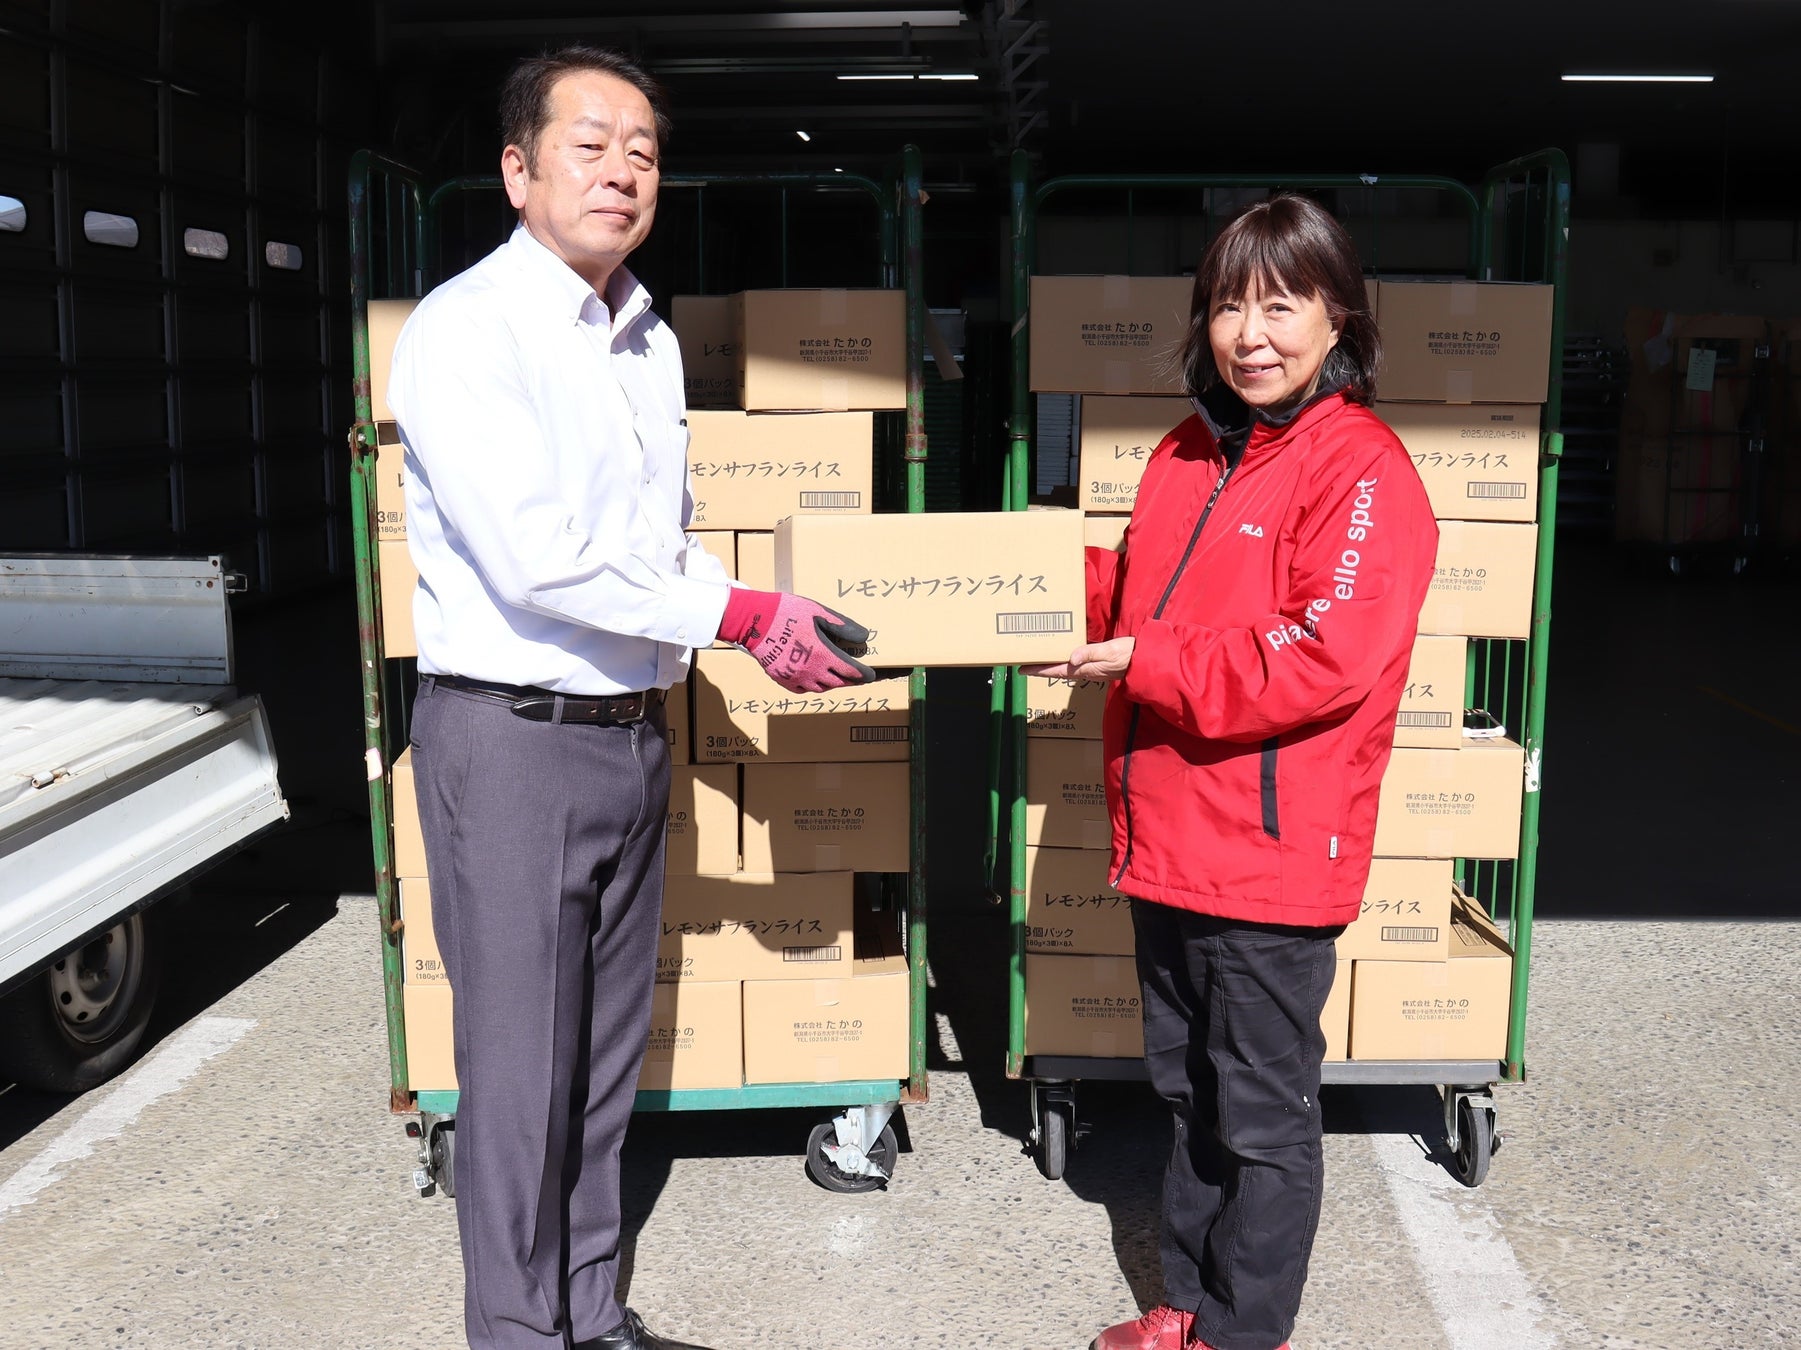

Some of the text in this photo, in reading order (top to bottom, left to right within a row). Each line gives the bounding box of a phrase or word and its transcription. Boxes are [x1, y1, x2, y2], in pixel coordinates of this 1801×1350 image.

[1115, 322, 1153, 333] たかの
[1462, 330, 1501, 342] たかの
[833, 337, 872, 348] たかの
[1460, 429, 1527, 440] 2025.02.04-514
[1409, 452, 1509, 470] フランライス
[689, 461, 842, 479] モンサフランライス
[1347, 477, 1378, 542] sport
[1238, 523, 1264, 538] FILA
[1449, 567, 1487, 578] たかの
[836, 573, 1048, 599] レモンサフランライス
[779, 617, 798, 646] Lite
[1402, 682, 1434, 699] イス
[728, 696, 891, 715] レモンサフランライス
[706, 735, 760, 747] 3個パック
[1438, 792, 1475, 803] たかの
[827, 807, 865, 818] たかの
[663, 918, 823, 936] レモンサフランライス
[1103, 996, 1139, 1007] たかの
[1433, 998, 1470, 1008] たかの
[826, 1019, 863, 1030] たかの
[657, 1027, 695, 1037] たかの
